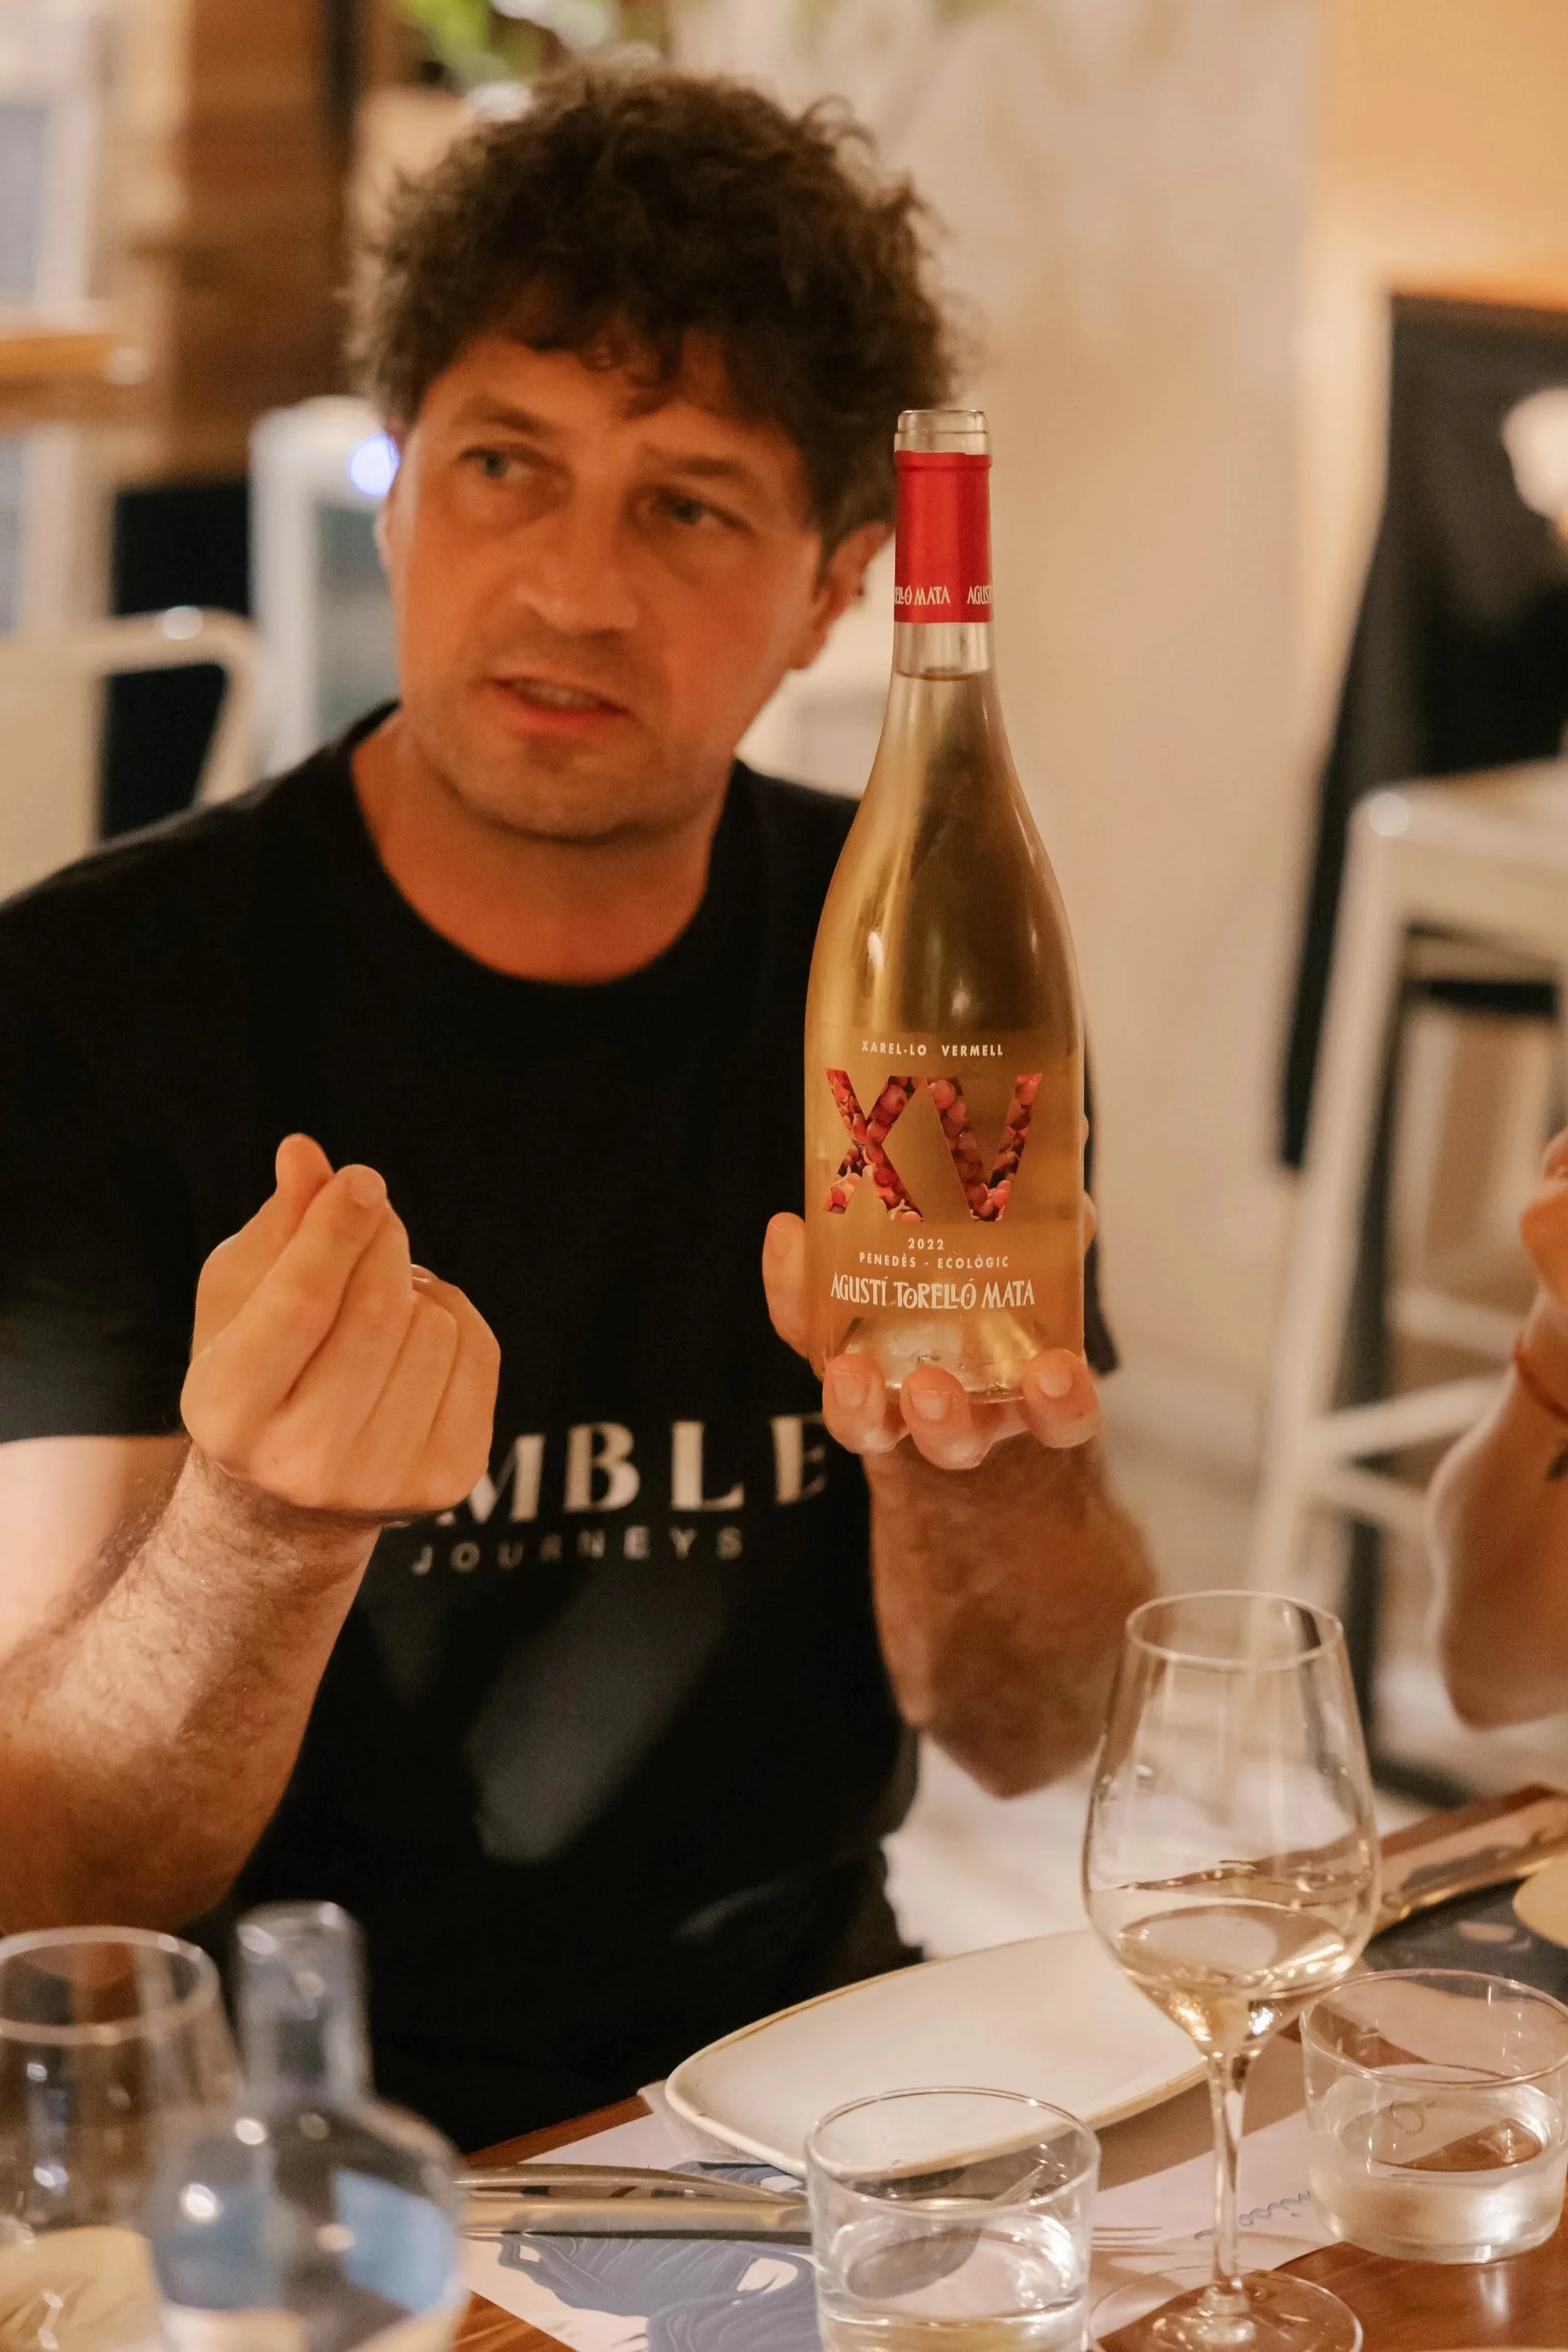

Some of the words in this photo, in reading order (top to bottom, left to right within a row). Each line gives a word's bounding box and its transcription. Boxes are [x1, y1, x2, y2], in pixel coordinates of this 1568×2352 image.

[914, 585, 951, 606] MATA
[941, 1044, 1003, 1057] VERMELL
[823, 1068, 1043, 1222] XV
[907, 1238, 945, 1250] 2022
[858, 1251, 916, 1268] PENEDÈS
[937, 1254, 1009, 1269] ECOLÒGIC
[830, 1272, 888, 1309] AGUSTÍ
[893, 1277, 977, 1310] TORELLÓ
[980, 1278, 1035, 1309] MATA
[437, 1413, 826, 1526] MBLE
[411, 1526, 743, 1576] JOURNEYS
